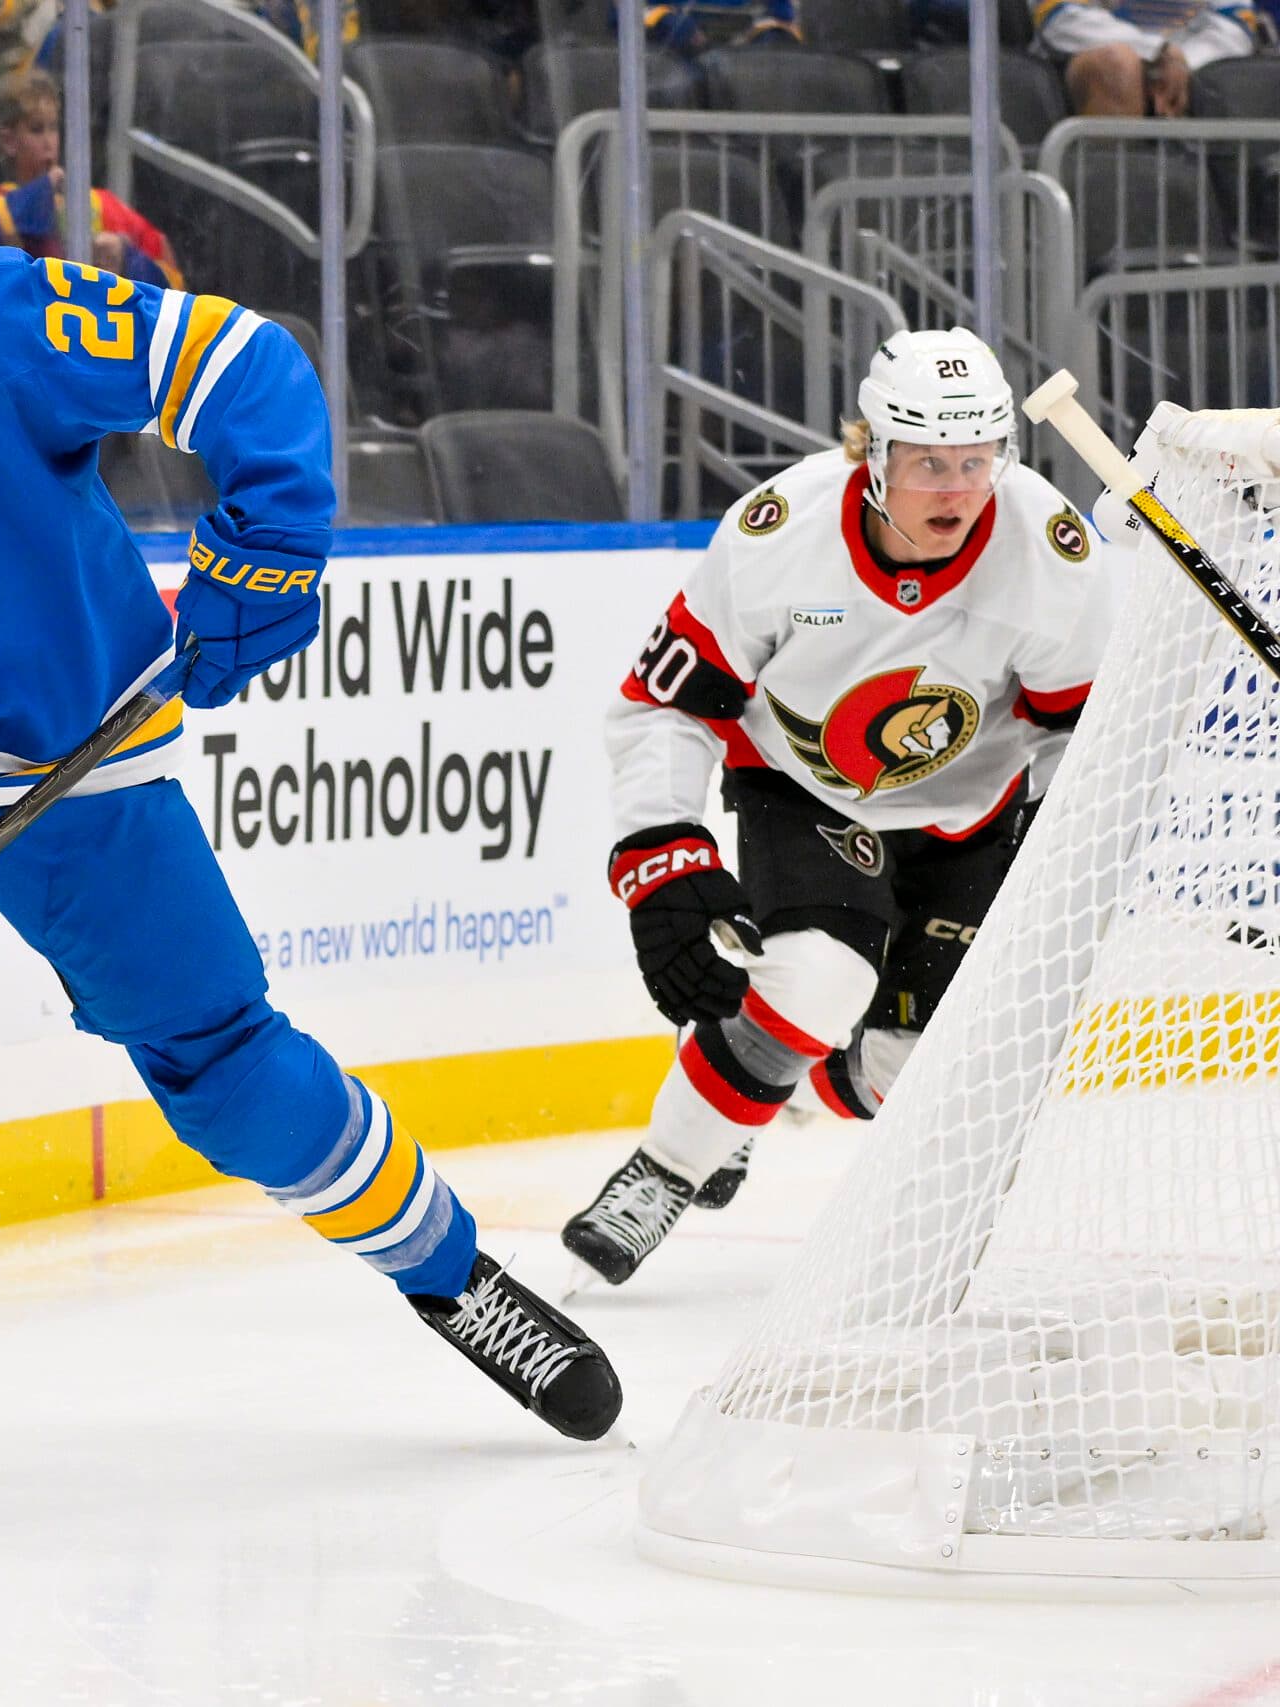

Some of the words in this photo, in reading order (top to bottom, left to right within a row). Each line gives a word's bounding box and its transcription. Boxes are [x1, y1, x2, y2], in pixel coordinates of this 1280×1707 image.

[936, 359, 969, 378] 20
[937, 410, 985, 421] CCM
[392, 577, 554, 693] Wide
[793, 613, 844, 626] CALIAN
[203, 722, 552, 861] Technology
[618, 848, 710, 901] CCM
[279, 930, 292, 968] a
[301, 924, 355, 967] new
[361, 902, 436, 958] world
[445, 901, 553, 962] happen
[925, 918, 978, 944] CC
